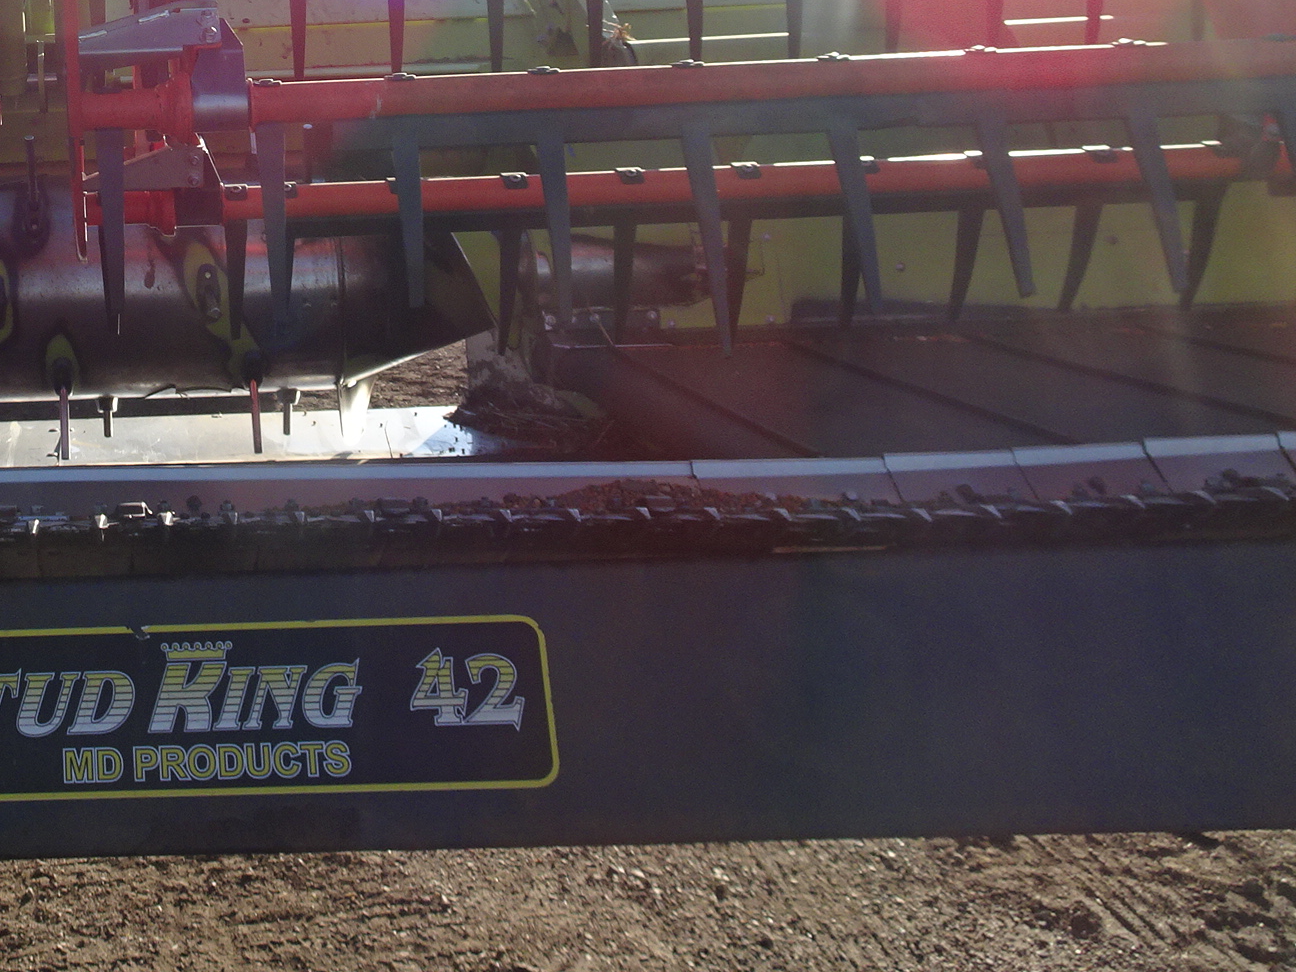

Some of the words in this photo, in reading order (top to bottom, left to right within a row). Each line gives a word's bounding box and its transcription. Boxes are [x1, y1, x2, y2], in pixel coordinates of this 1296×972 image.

[148, 657, 361, 733] KING
[409, 647, 525, 731] 42
[62, 747, 124, 783] MD
[133, 741, 352, 782] PRODUCTS
